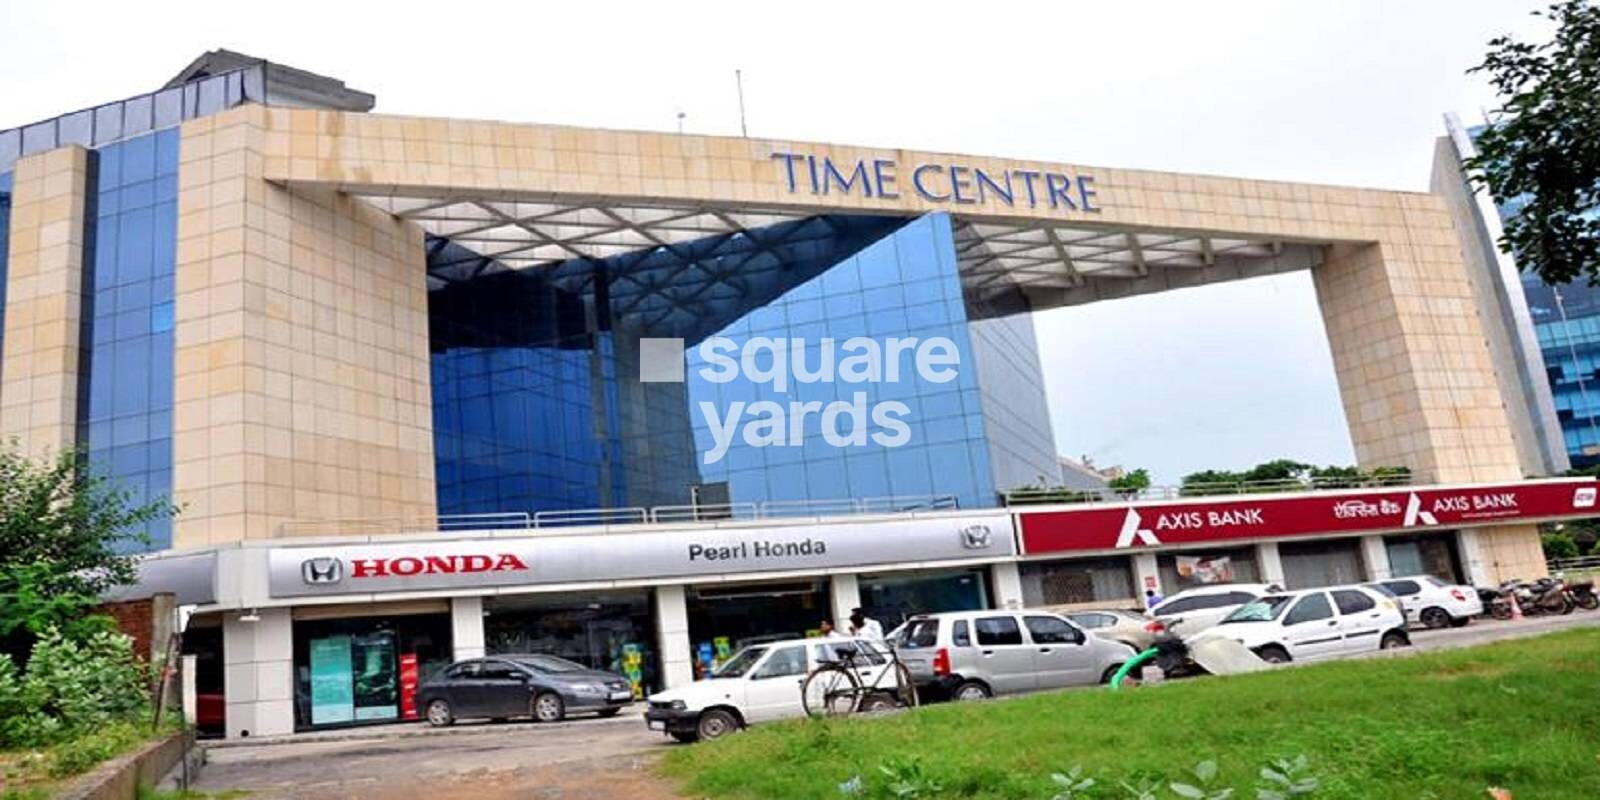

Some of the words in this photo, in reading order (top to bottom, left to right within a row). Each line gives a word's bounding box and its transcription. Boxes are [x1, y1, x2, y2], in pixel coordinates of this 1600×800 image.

[770, 151, 900, 200] TIME
[913, 164, 1102, 214] CENTRE
[1433, 495, 1470, 513] AXIS
[1472, 492, 1519, 509] BANK
[1156, 511, 1203, 530] AXIS
[1208, 508, 1264, 526] BANK
[688, 541, 748, 562] Pearl
[753, 538, 827, 558] Honda
[350, 553, 529, 578] HONDA
